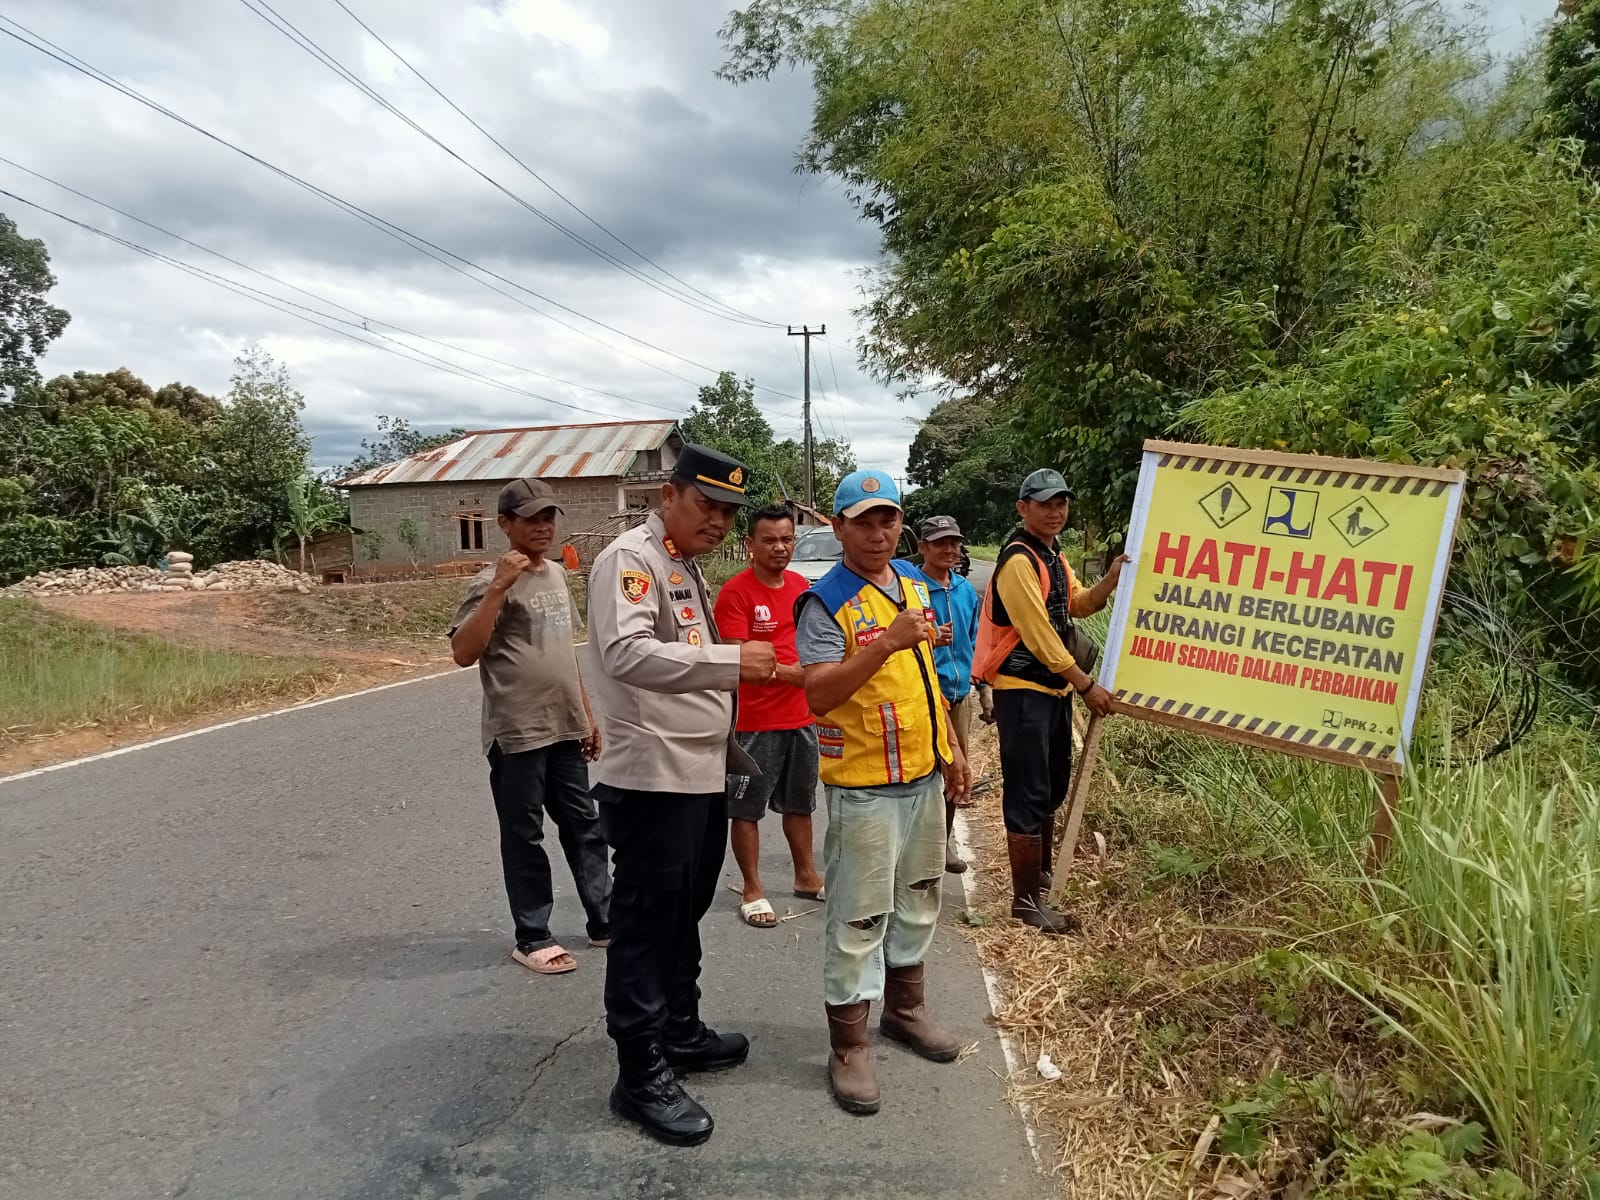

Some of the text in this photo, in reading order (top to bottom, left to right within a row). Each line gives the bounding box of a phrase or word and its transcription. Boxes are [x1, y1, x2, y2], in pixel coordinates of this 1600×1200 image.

[1153, 532, 1413, 610] HATI-HATI
[1135, 609, 1404, 675] KURANGI KECEPATAN
[1154, 582, 1395, 639] JALAN BERLUBANG
[1129, 635, 1398, 705] JALAN SEDANG DALAM PERBAIKAN
[1343, 717, 1368, 731] PPK
